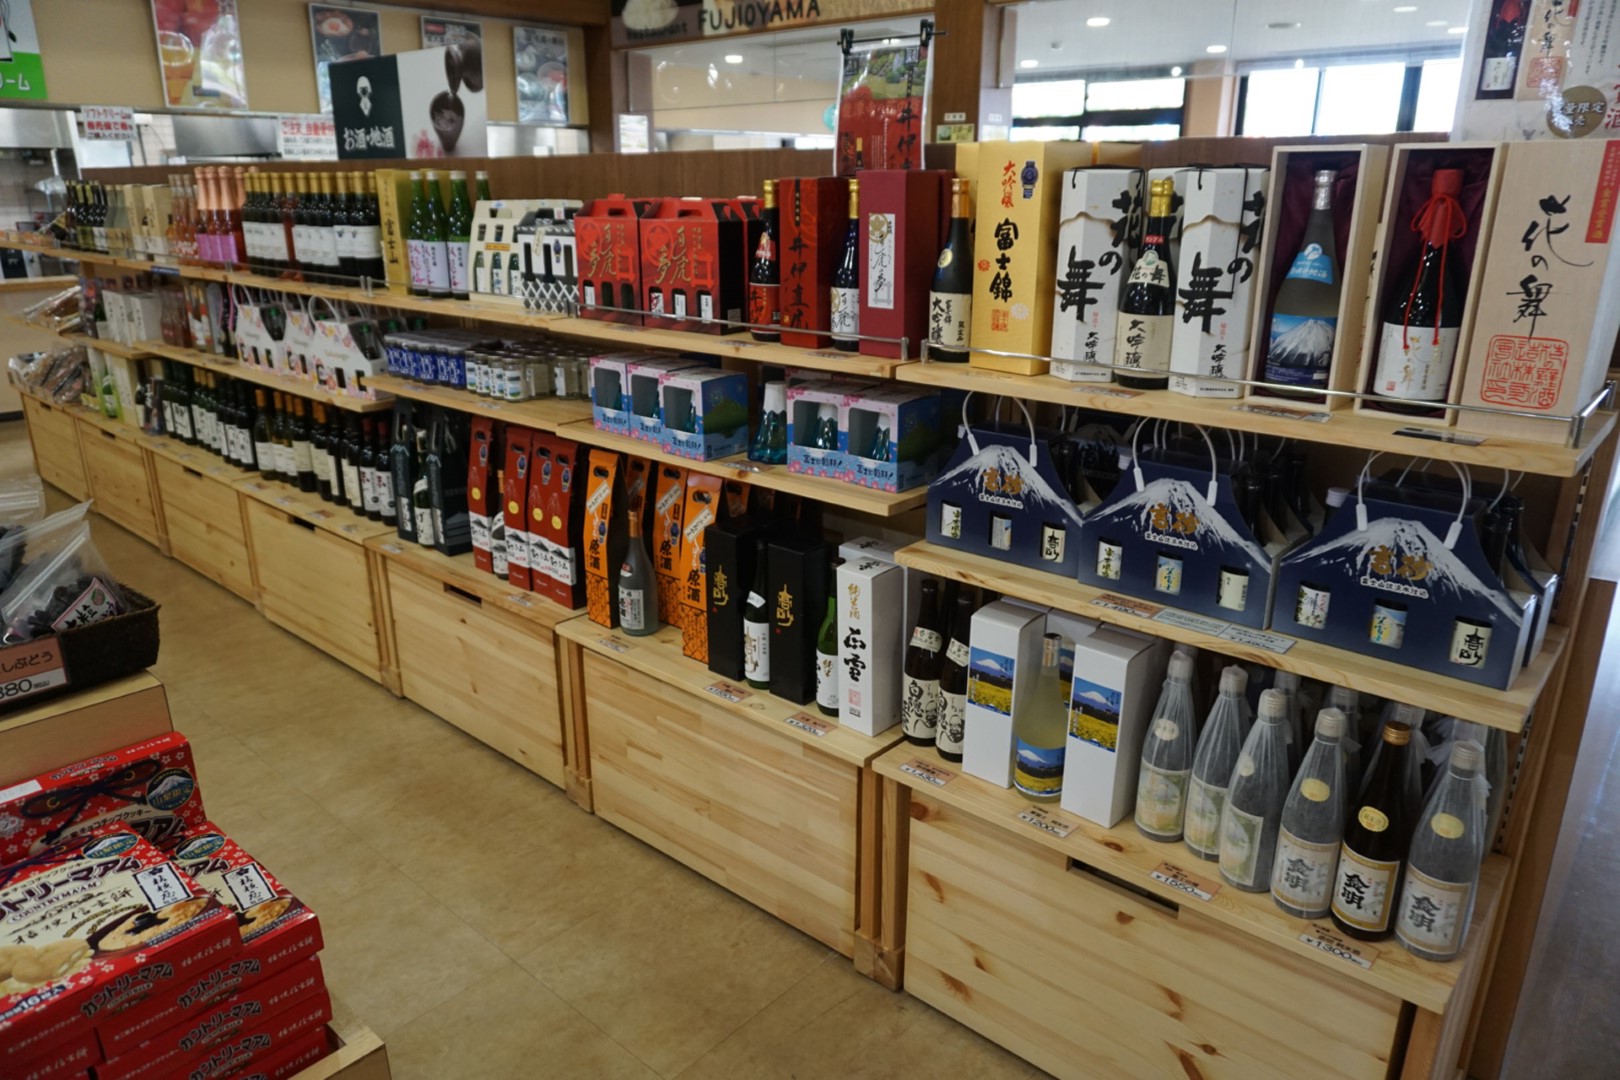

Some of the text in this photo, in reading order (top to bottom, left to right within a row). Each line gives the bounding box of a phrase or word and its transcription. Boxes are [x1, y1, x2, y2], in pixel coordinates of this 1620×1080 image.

[0, 72, 31, 92] ーム
[1560, 101, 1605, 115] 量限定
[343, 126, 395, 150] お酒・地酒
[989, 217, 1020, 304] 富士錦
[1130, 265, 1167, 285] 花の舞
[1506, 194, 1594, 343] 花の舞
[1126, 319, 1147, 369] 大吟醸
[1361, 576, 1428, 599] 富士山伏流水仕込
[0, 651, 54, 674] しぶどう
[1285, 857, 1315, 893] 金明
[1341, 872, 1371, 911] 金明
[1408, 893, 1442, 934] 金明
[1306, 936, 1352, 961] ¥1300
[81, 962, 174, 1018] カントリーマアム
[177, 959, 261, 1009] カントリーマアム
[179, 1000, 262, 1051] カントリーマアム
